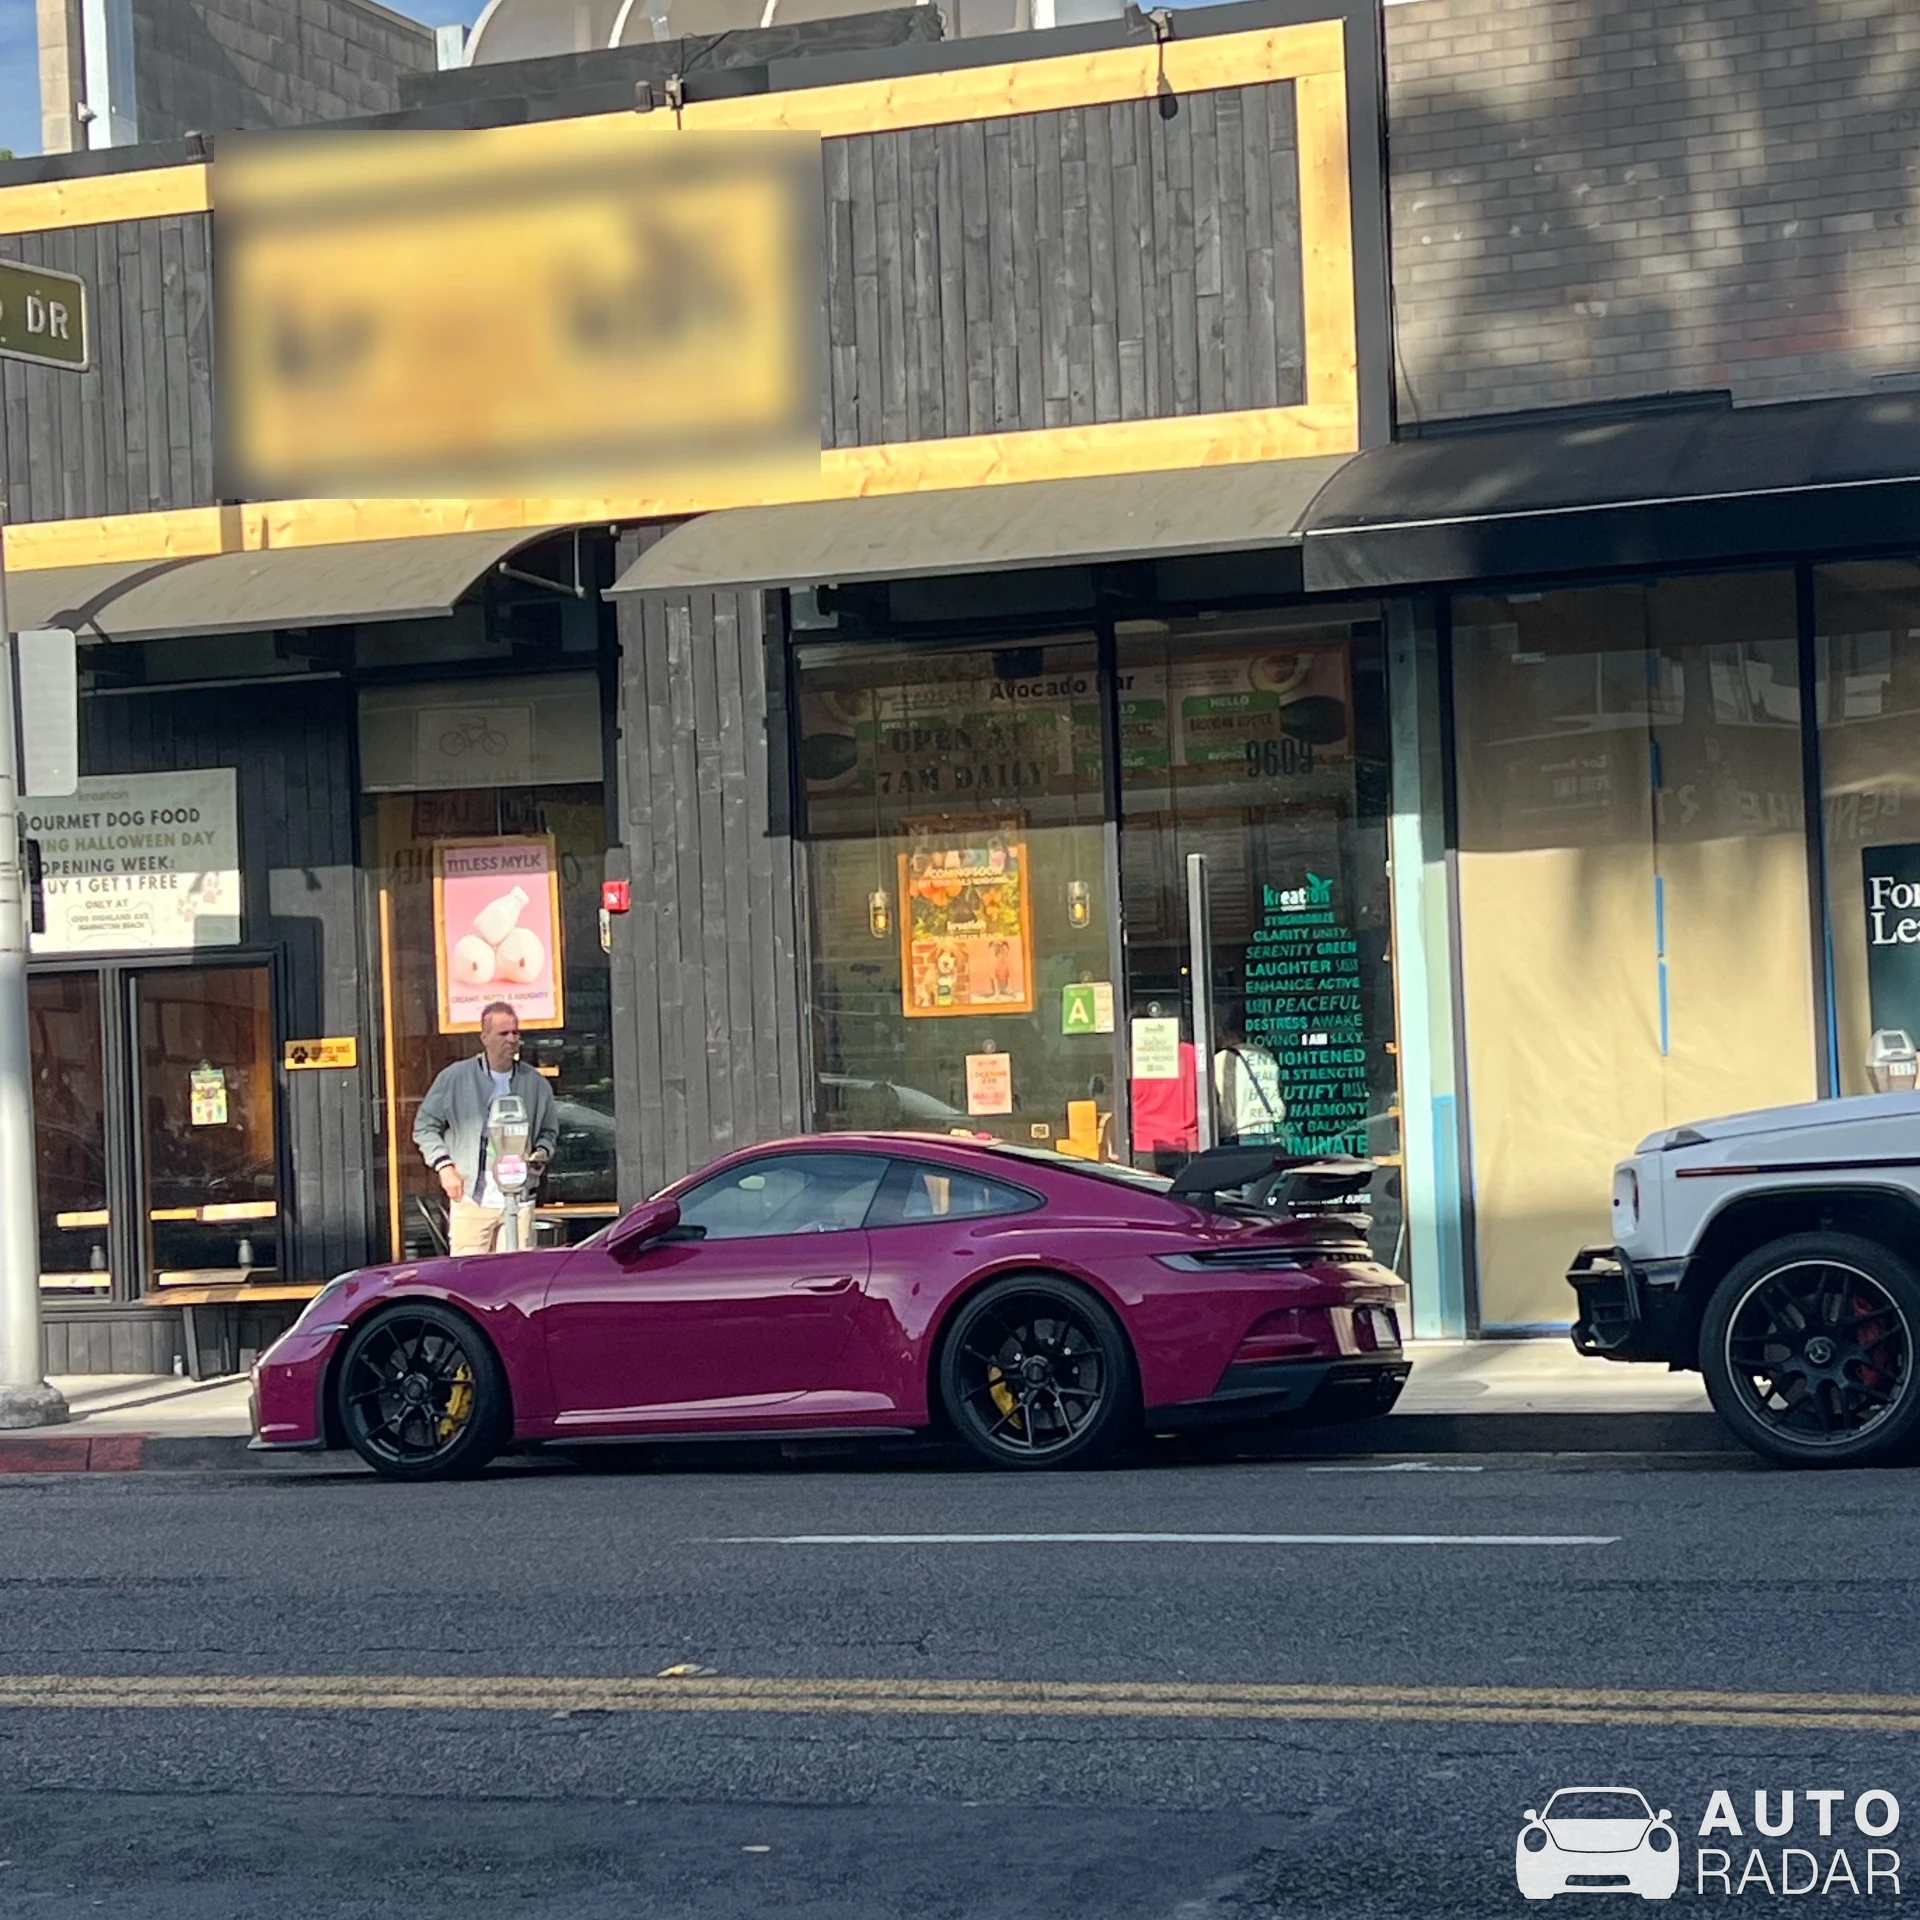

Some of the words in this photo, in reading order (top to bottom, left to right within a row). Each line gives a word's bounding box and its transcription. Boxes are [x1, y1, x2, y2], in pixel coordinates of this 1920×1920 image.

[27, 295, 69, 340] DR
[988, 675, 1087, 701] Avocado
[878, 768, 939, 794] 7AM
[954, 761, 1047, 790] DAILY
[28, 812, 101, 831] OURMET
[107, 811, 145, 828] DOG
[151, 807, 201, 825] FOOD
[75, 832, 176, 852] HALLOWEEN
[181, 831, 216, 846] DAY
[41, 857, 115, 875] OPENING
[447, 856, 498, 872] TITLESS
[501, 853, 542, 869] MYLK
[75, 879, 82, 893] 1
[88, 876, 119, 893] GET
[126, 876, 132, 891] 1
[139, 873, 178, 890] FREE
[115, 899, 129, 908] AT
[1263, 883, 1331, 906] kreation
[1253, 928, 1309, 942] CLARITY
[1312, 927, 1348, 939] UNITY
[1870, 911, 1920, 946] Le
[1246, 943, 1314, 959] SERENITY
[1317, 941, 1357, 955] GREEN
[1245, 959, 1331, 977] LAUGHTER
[1245, 977, 1315, 993] ENHANCE
[1067, 997, 1089, 1025] A
[1275, 995, 1361, 1012] PEACEFUL
[1245, 1016, 1308, 1032] DESTRESS
[1311, 1013, 1363, 1028] AWAKE
[1330, 1032, 1363, 1044] SEXY
[1293, 1066, 1365, 1080] STRENGTH
[1290, 1101, 1369, 1117] HARMONY
